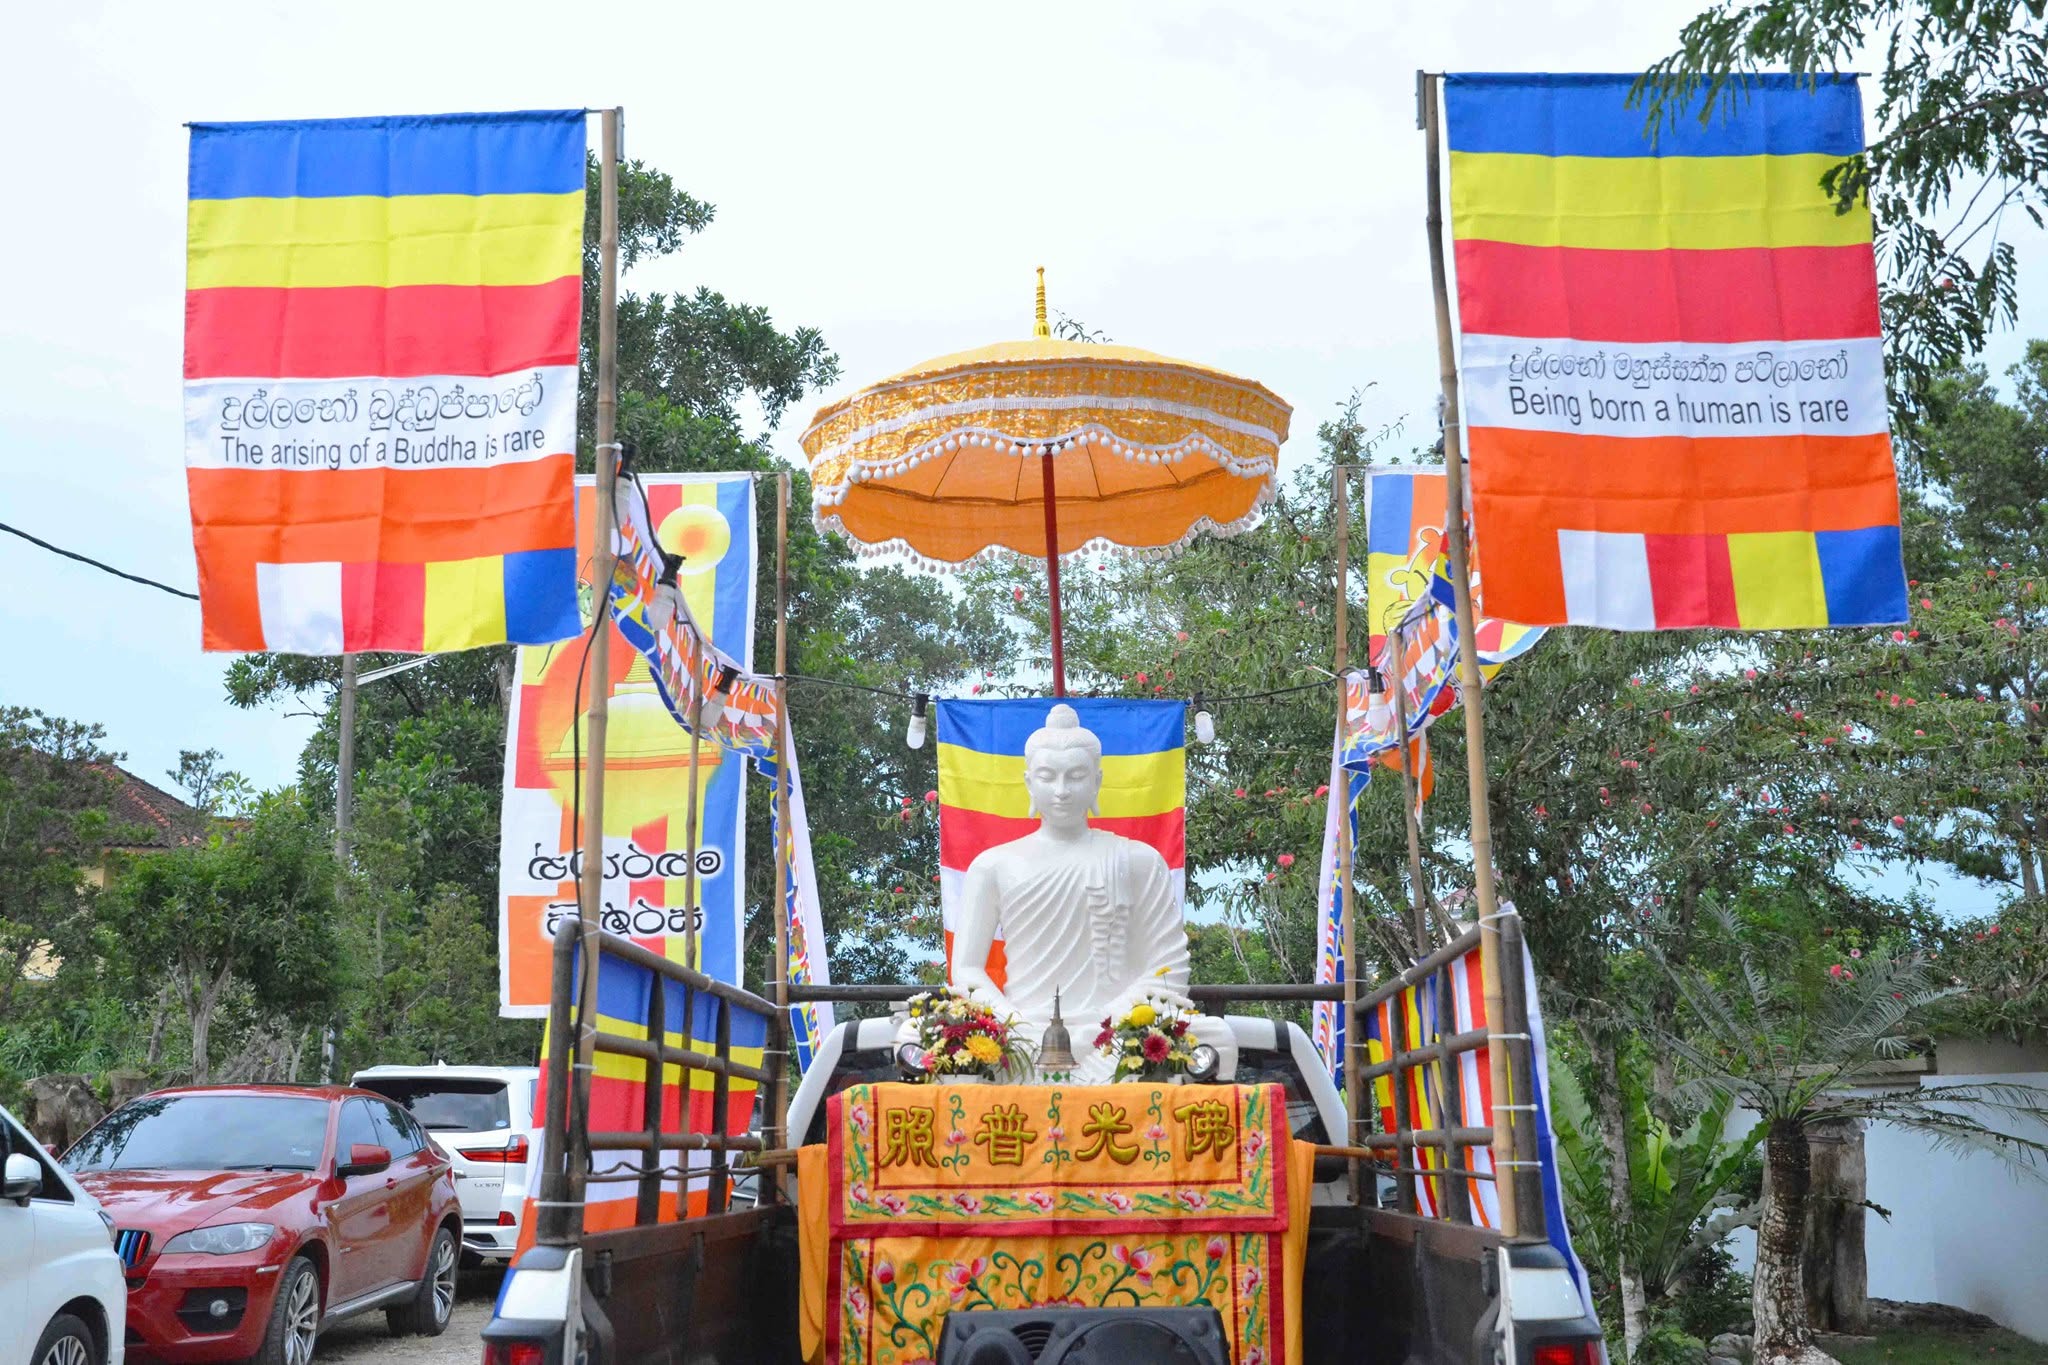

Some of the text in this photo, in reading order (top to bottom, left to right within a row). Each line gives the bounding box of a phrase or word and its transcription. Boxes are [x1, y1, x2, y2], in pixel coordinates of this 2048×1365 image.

[1510, 386, 1849, 426] Being born a human is rare
[221, 428, 546, 471] The arising of a Buddha is rare
